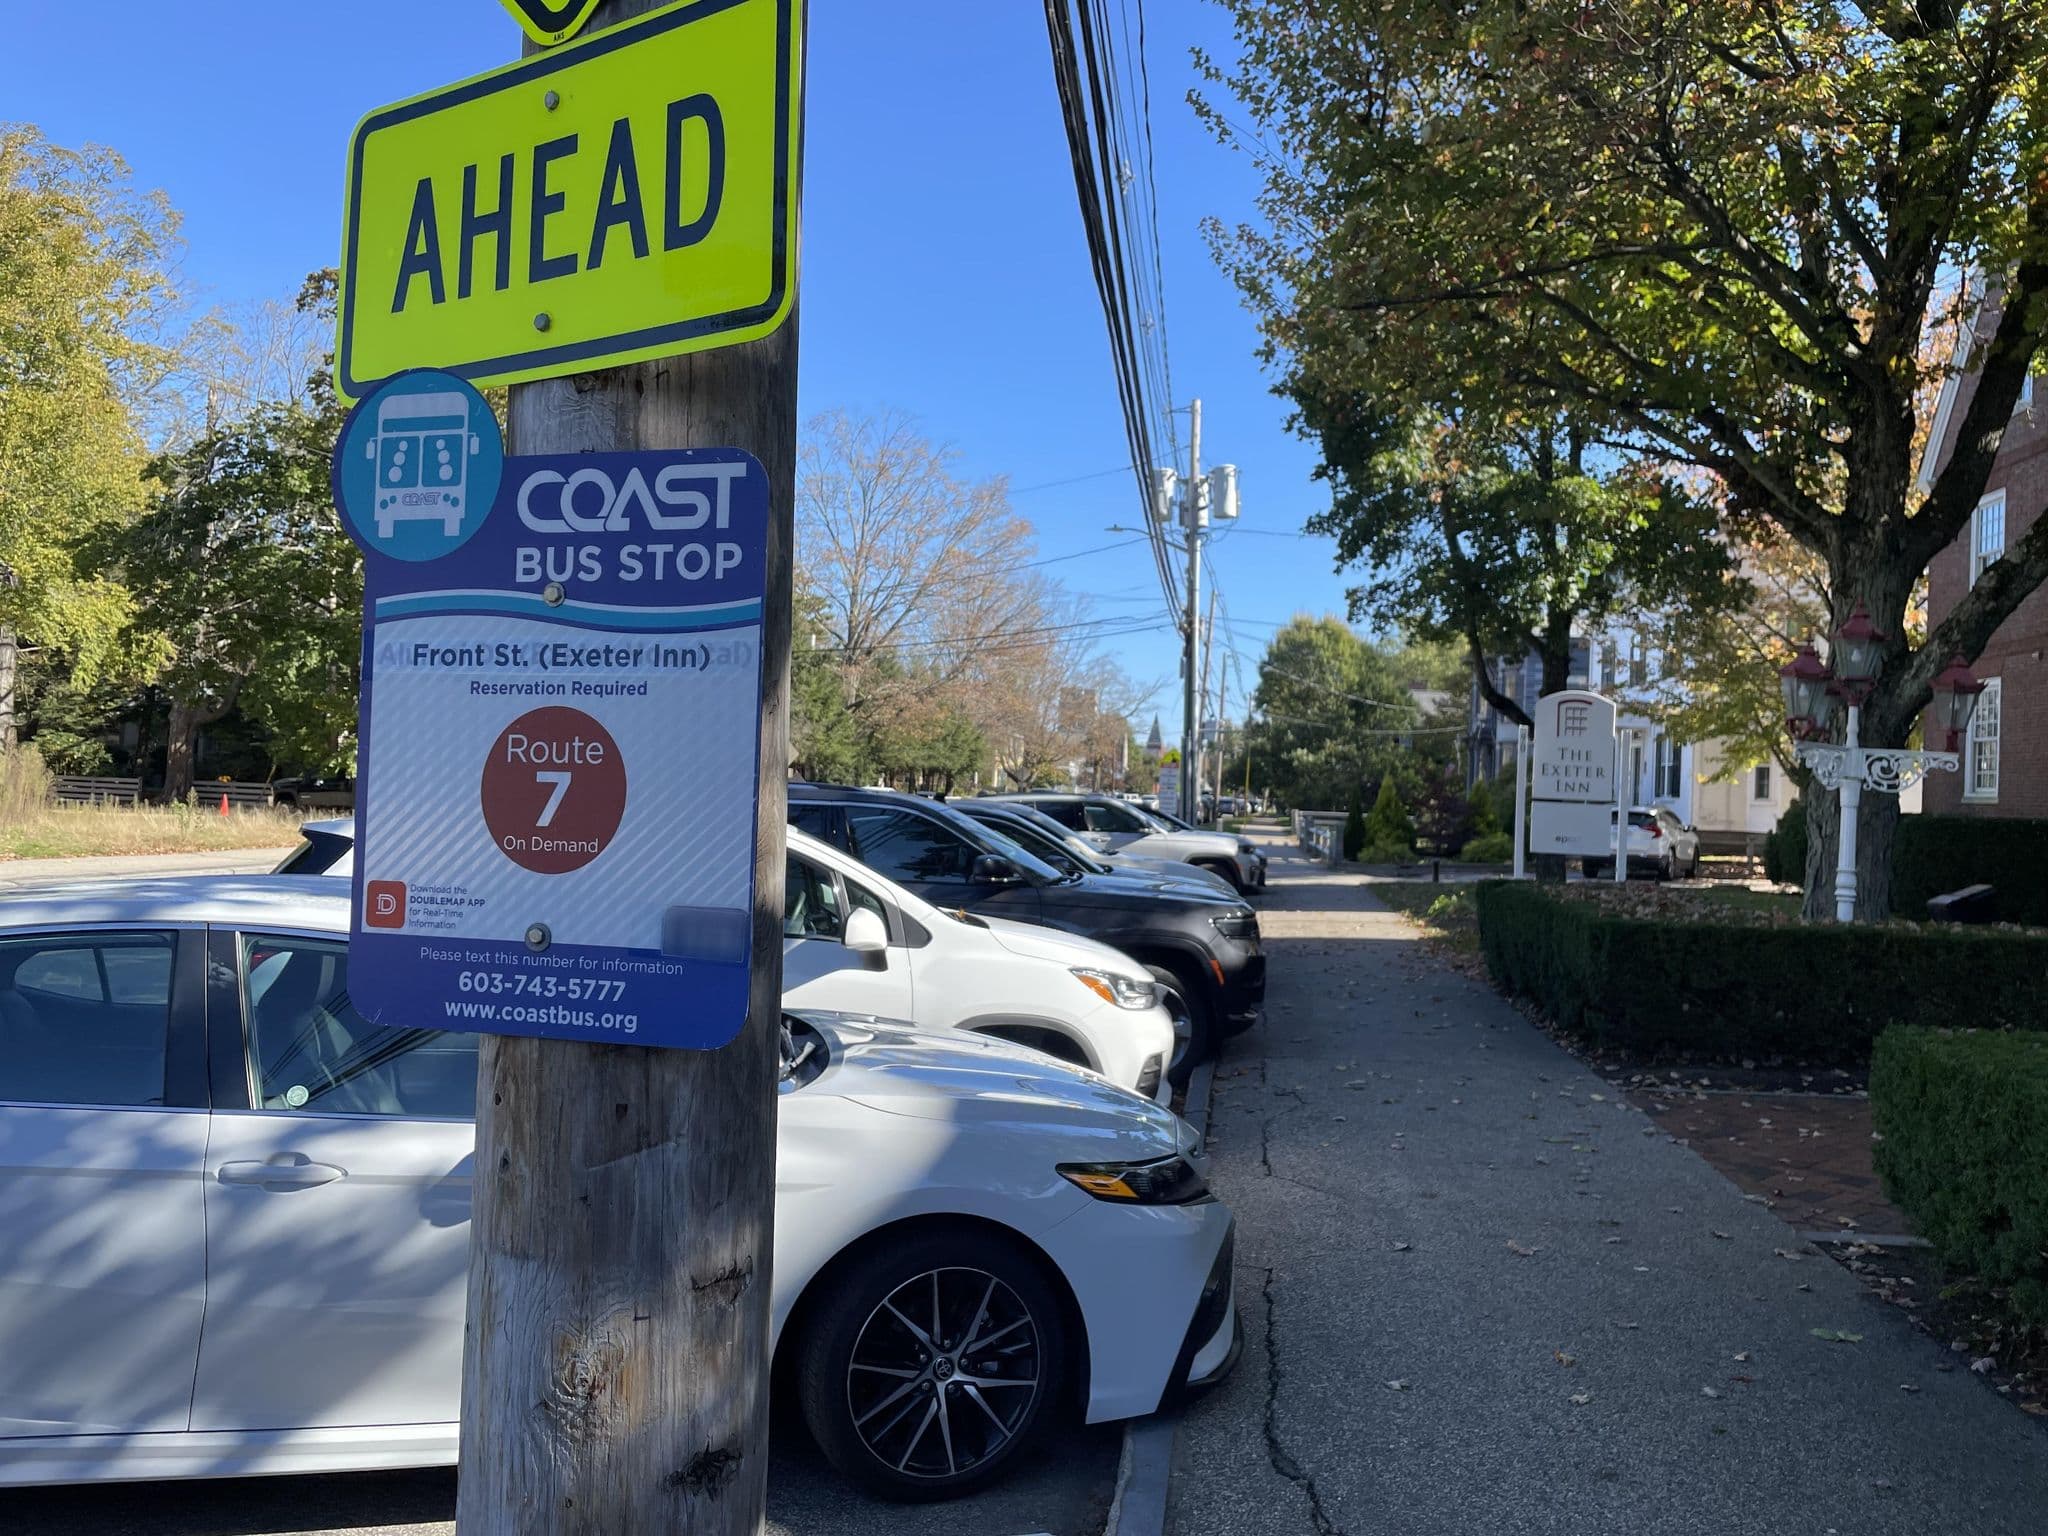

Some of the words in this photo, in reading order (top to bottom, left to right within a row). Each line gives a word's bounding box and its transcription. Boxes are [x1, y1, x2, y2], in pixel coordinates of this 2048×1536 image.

[391, 93, 725, 313] AHEAD
[516, 462, 747, 533] COAST
[515, 545, 602, 583] BUS
[618, 542, 743, 581] STOP
[412, 643, 485, 668] Front
[494, 643, 529, 668] St.
[539, 643, 646, 671] (Exeter
[654, 643, 711, 672] Inn)
[470, 680, 566, 696] Reservation
[571, 680, 648, 698] Required
[507, 733, 605, 765] Route
[1559, 747, 1592, 762] THE
[1541, 763, 1606, 778] EXETER
[1556, 779, 1590, 793] INN
[535, 771, 573, 827] 7
[503, 835, 526, 852] On
[531, 836, 599, 854] Demand
[410, 884, 452, 895] Download
[454, 885, 468, 895] the
[409, 896, 465, 907] DOUBLEMAP
[467, 898, 486, 908] APP
[409, 907, 421, 917] for
[423, 907, 464, 919] Real-Time
[408, 918, 457, 930] Information
[420, 946, 462, 963] Please
[465, 949, 491, 964] text
[495, 949, 519, 965] this
[522, 951, 575, 969] number
[577, 954, 598, 970] for
[602, 955, 684, 976] information
[458, 970, 627, 1002] 603-743-5777
[444, 999, 638, 1034] www.coastbus.org
